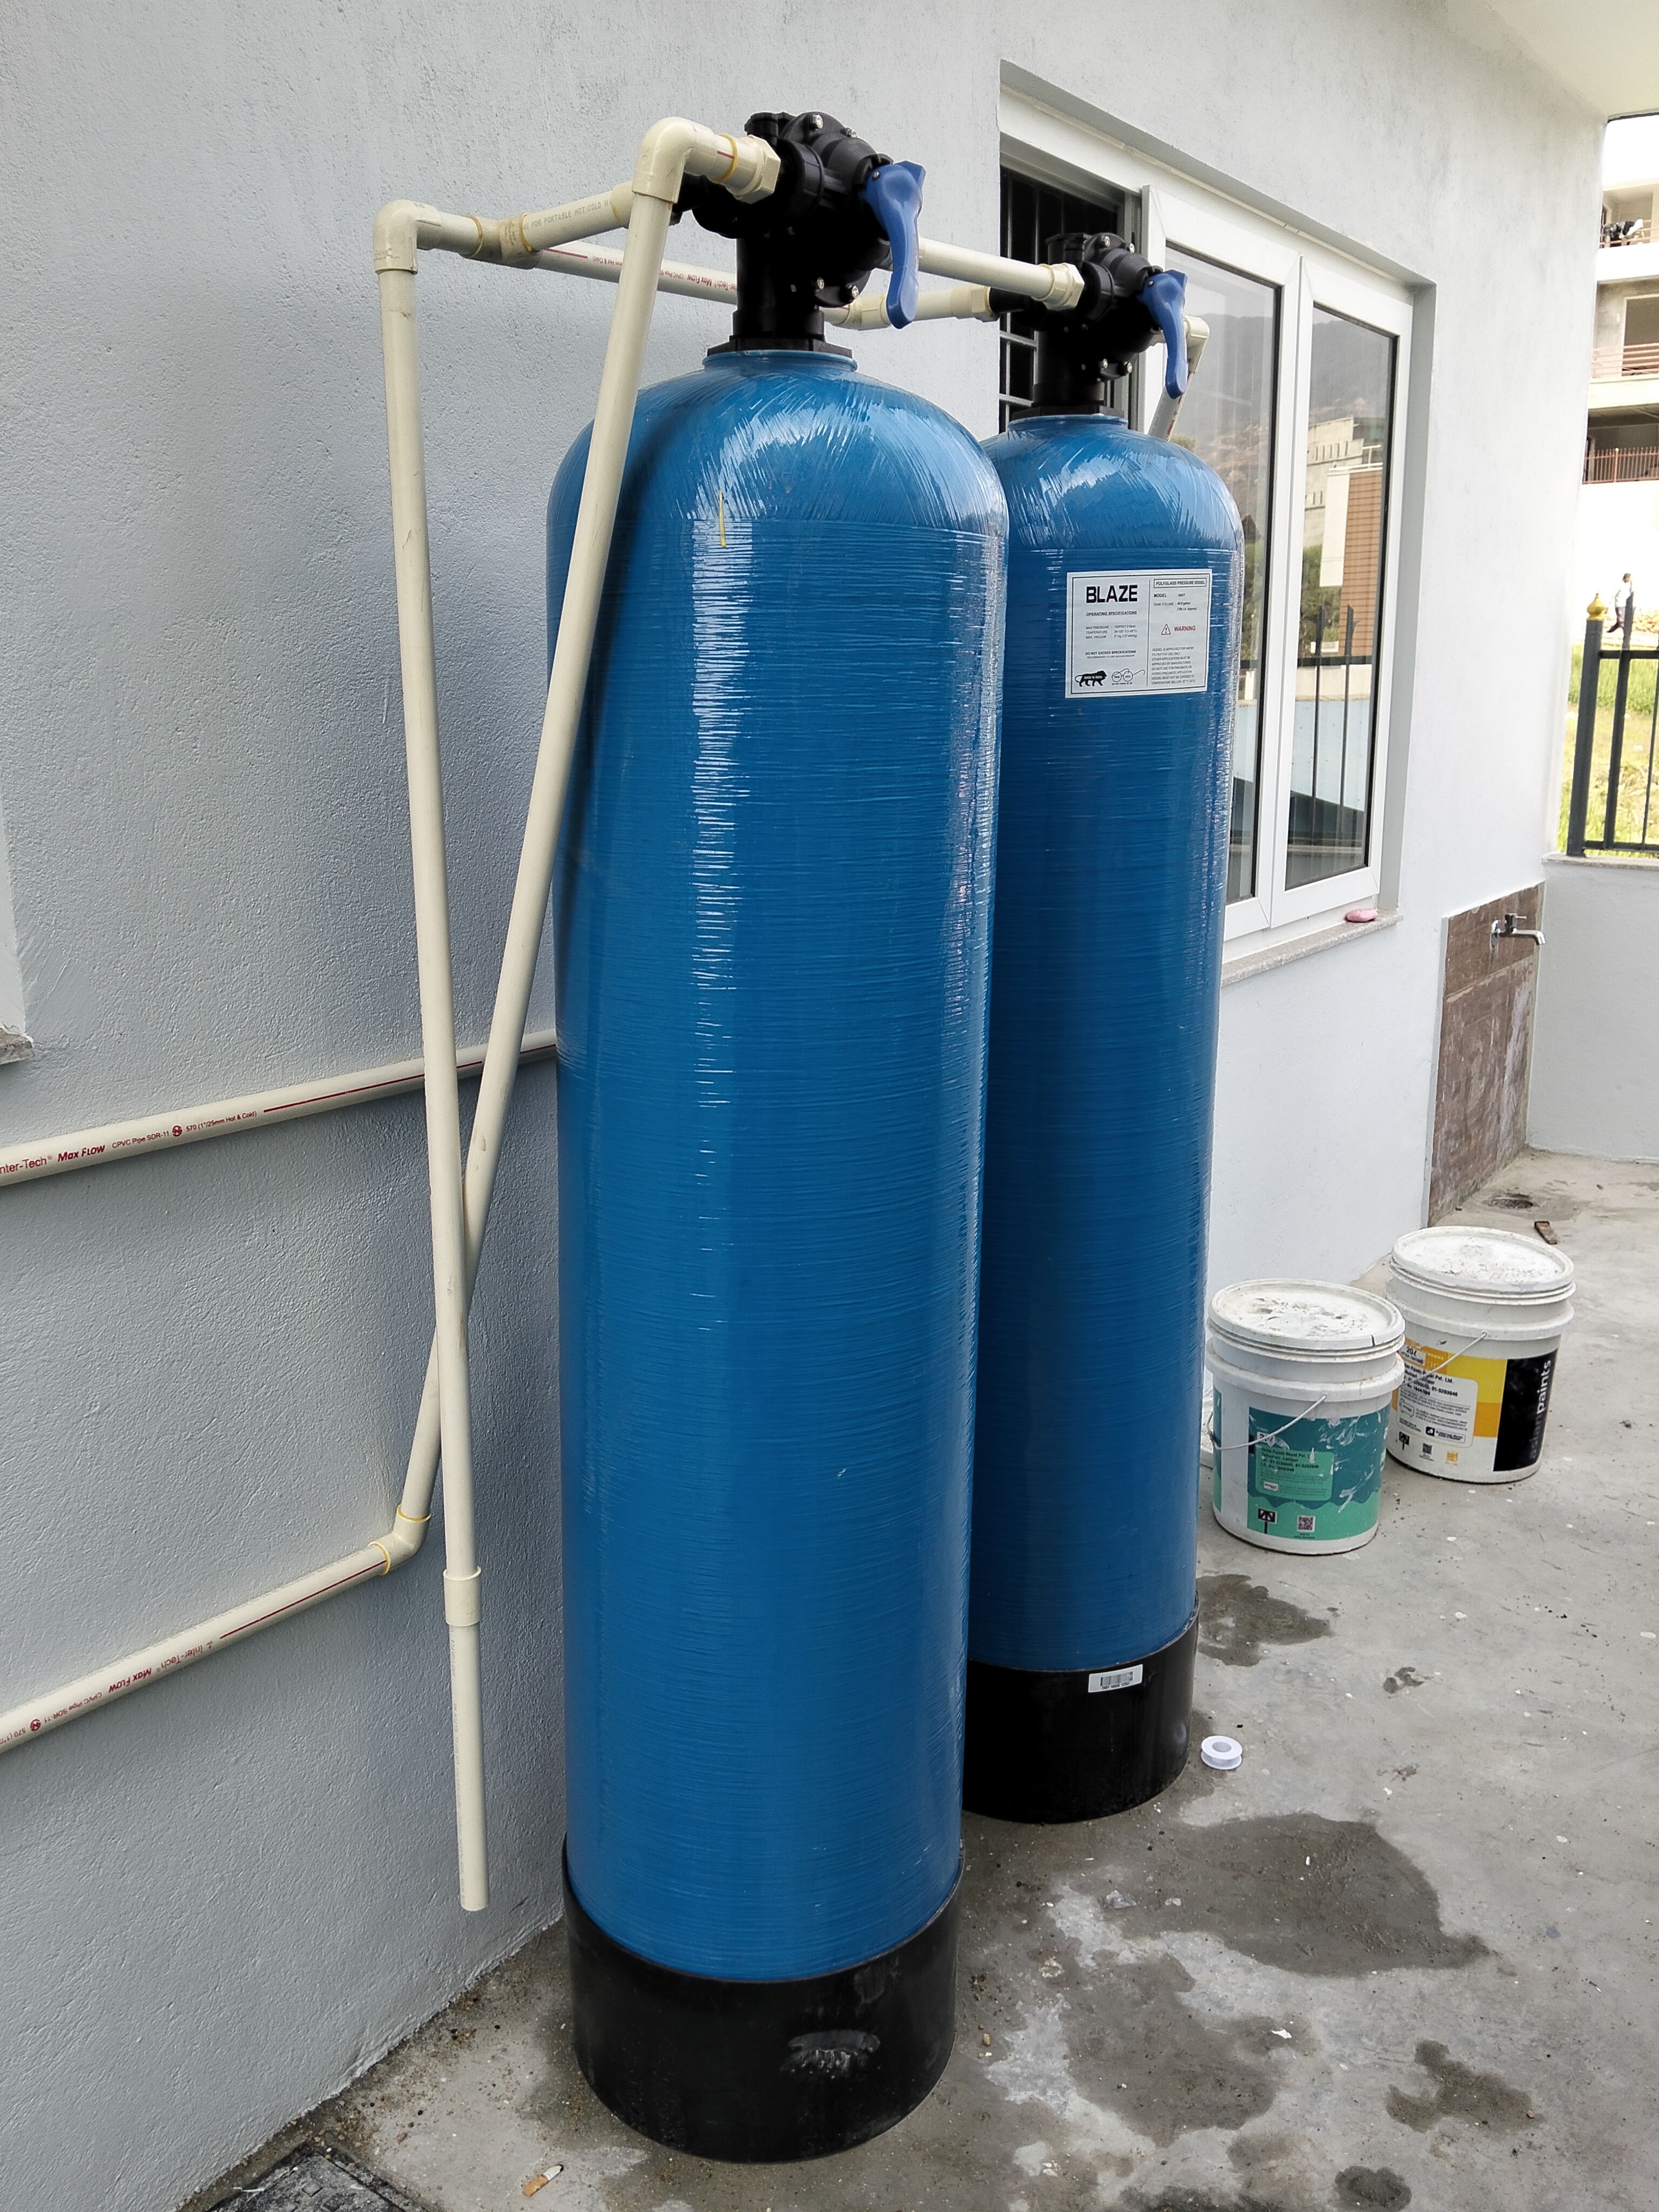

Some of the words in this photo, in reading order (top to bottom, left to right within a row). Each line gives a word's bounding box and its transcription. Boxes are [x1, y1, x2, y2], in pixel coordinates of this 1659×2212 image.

[531, 219, 542, 228] FOR
[544, 211, 572, 224] PORTABLE
[588, 201, 601, 211] COLD
[701, 278, 712, 286] Max
[1086, 585, 1138, 603] BLAZE
[0, 1156, 48, 1175] nter-Tech
[58, 1151, 79, 1162] Max
[82, 1144, 106, 1157] FLOW
[112, 1139, 131, 1149] CPVC
[132, 1136, 146, 1145] Pipe
[147, 1130, 170, 1141] SDR-11
[186, 1124, 197, 1132] 570
[242, 1110, 257, 1119] Cold)
[1536, 1360, 1552, 1414] paints
[133, 1667, 152, 1682] Max
[83, 1691, 103, 1705] CPVC
[69, 1702, 83, 1711] Pipe
[44, 1710, 68, 1724] SDR-11
[14, 1727, 26, 1738] 570
